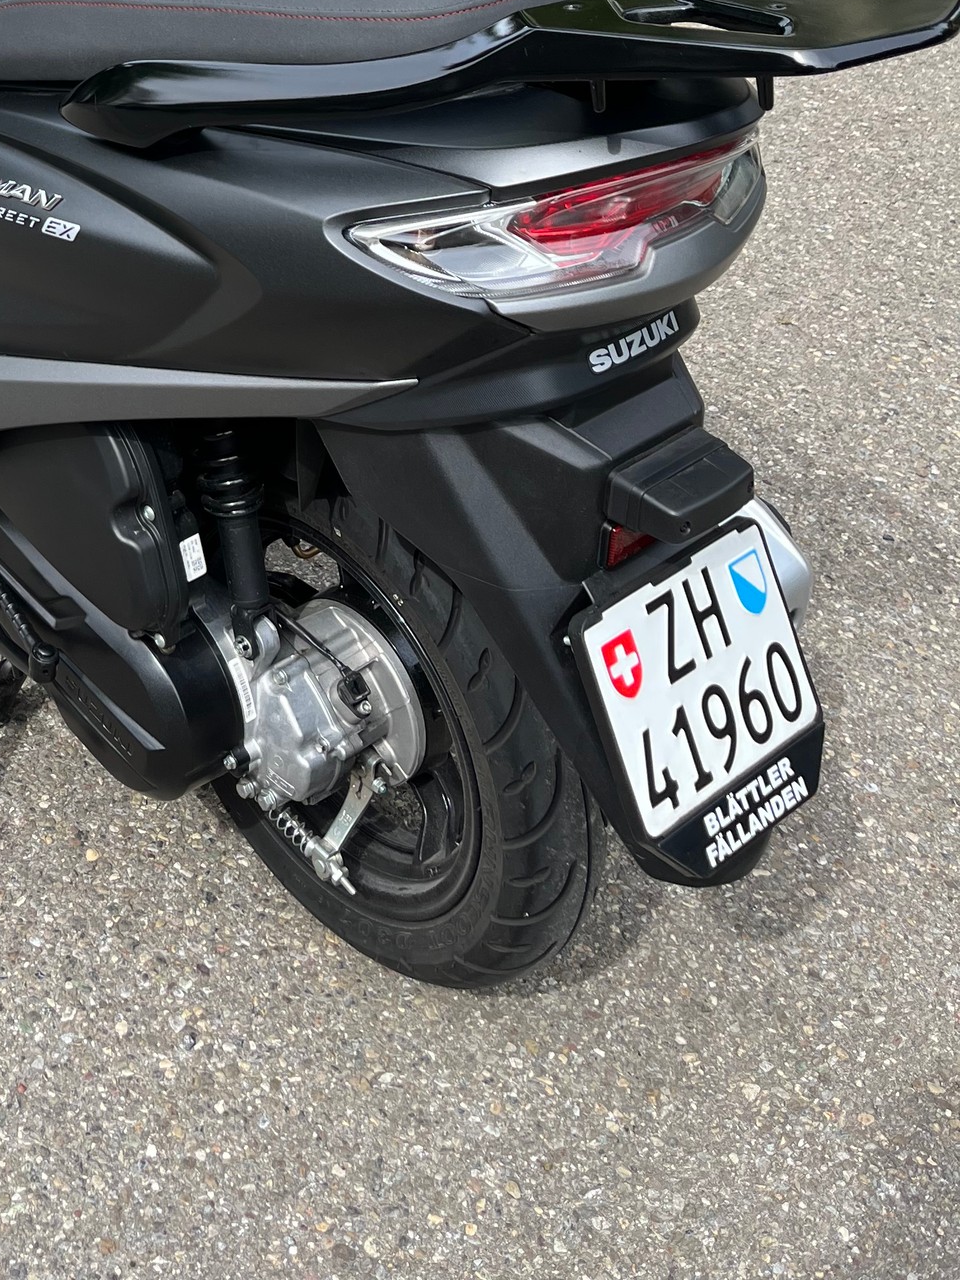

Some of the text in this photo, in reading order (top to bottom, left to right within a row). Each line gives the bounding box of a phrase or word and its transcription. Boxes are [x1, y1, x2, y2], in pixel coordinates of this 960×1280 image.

[44, 219, 77, 239] EX
[589, 310, 680, 373] SUZUKI
[646, 566, 733, 685] ZH
[642, 642, 803, 811] 41960
[704, 757, 795, 836] BLÄTTLER
[705, 786, 809, 869] FÄLLANDEN
